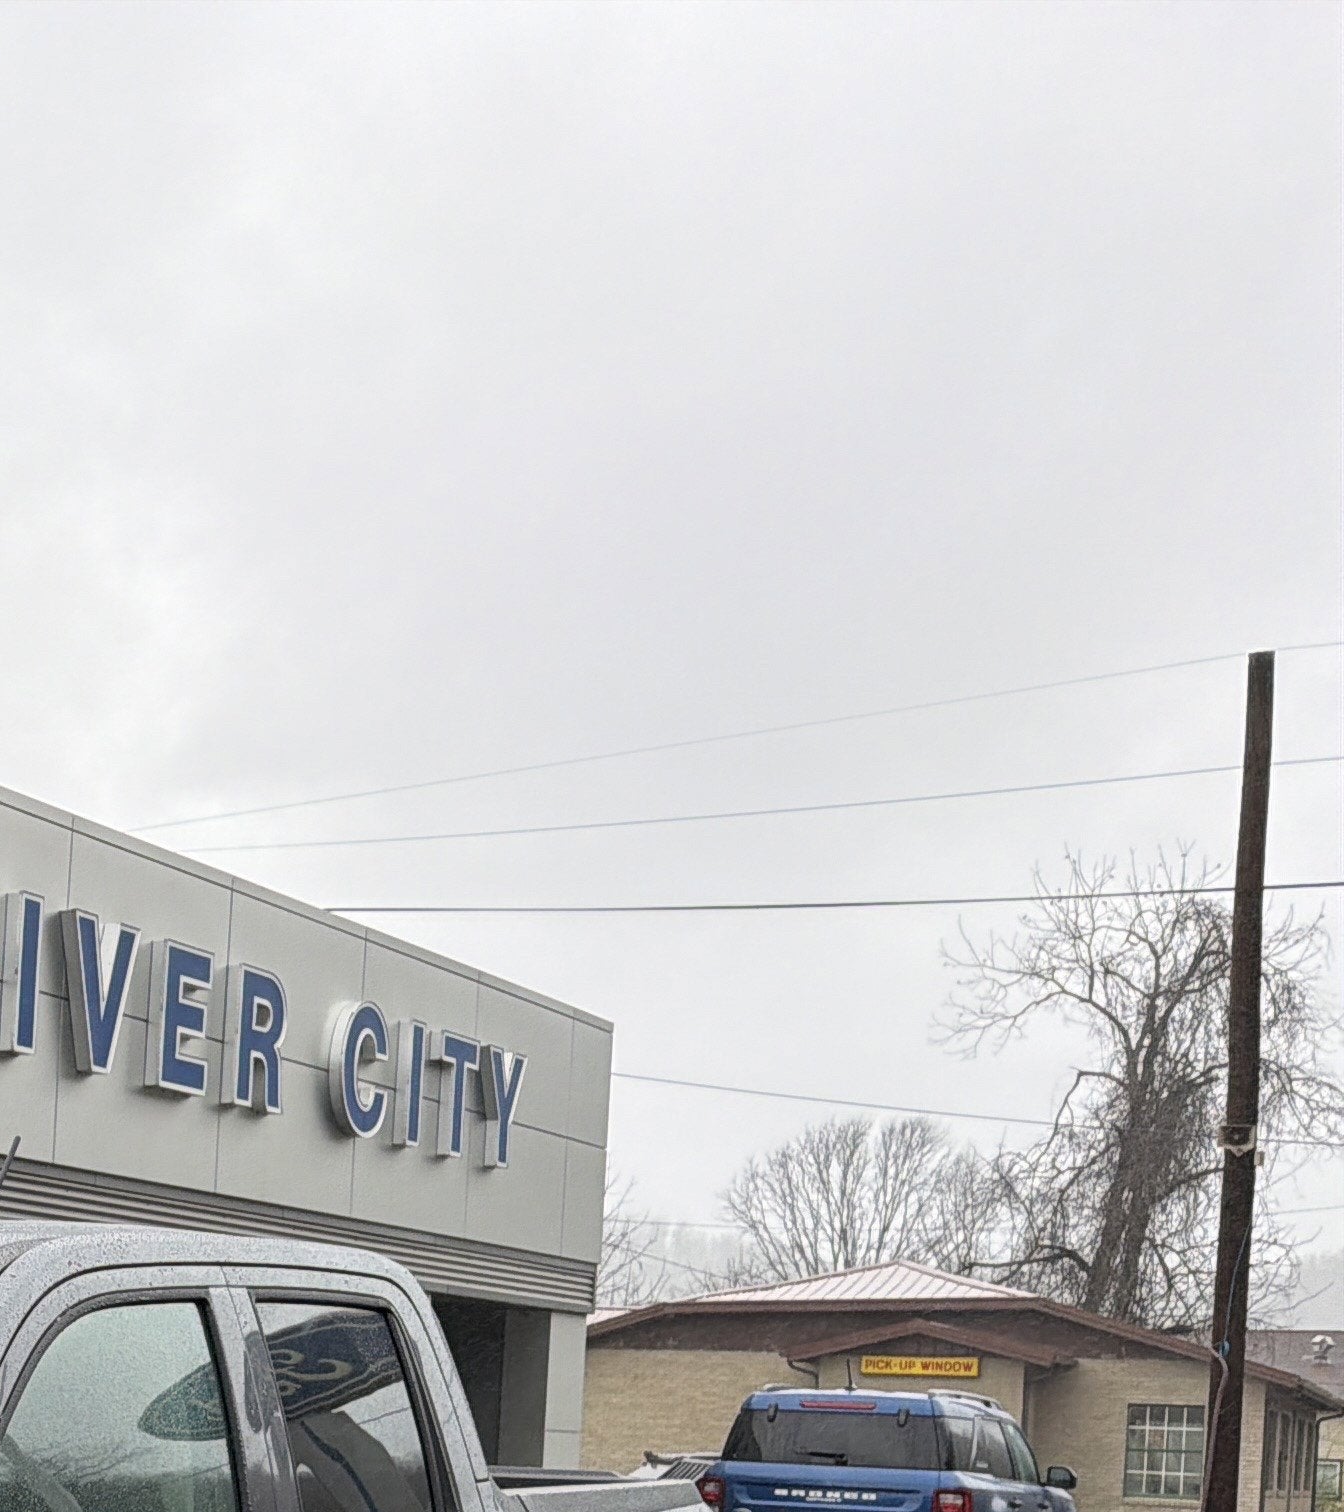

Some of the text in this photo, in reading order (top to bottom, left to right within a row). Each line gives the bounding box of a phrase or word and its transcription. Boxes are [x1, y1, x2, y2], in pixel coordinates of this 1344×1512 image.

[329, 1000, 528, 1169] CITY
[864, 1358, 974, 1372] PICK-UP WINDOW
